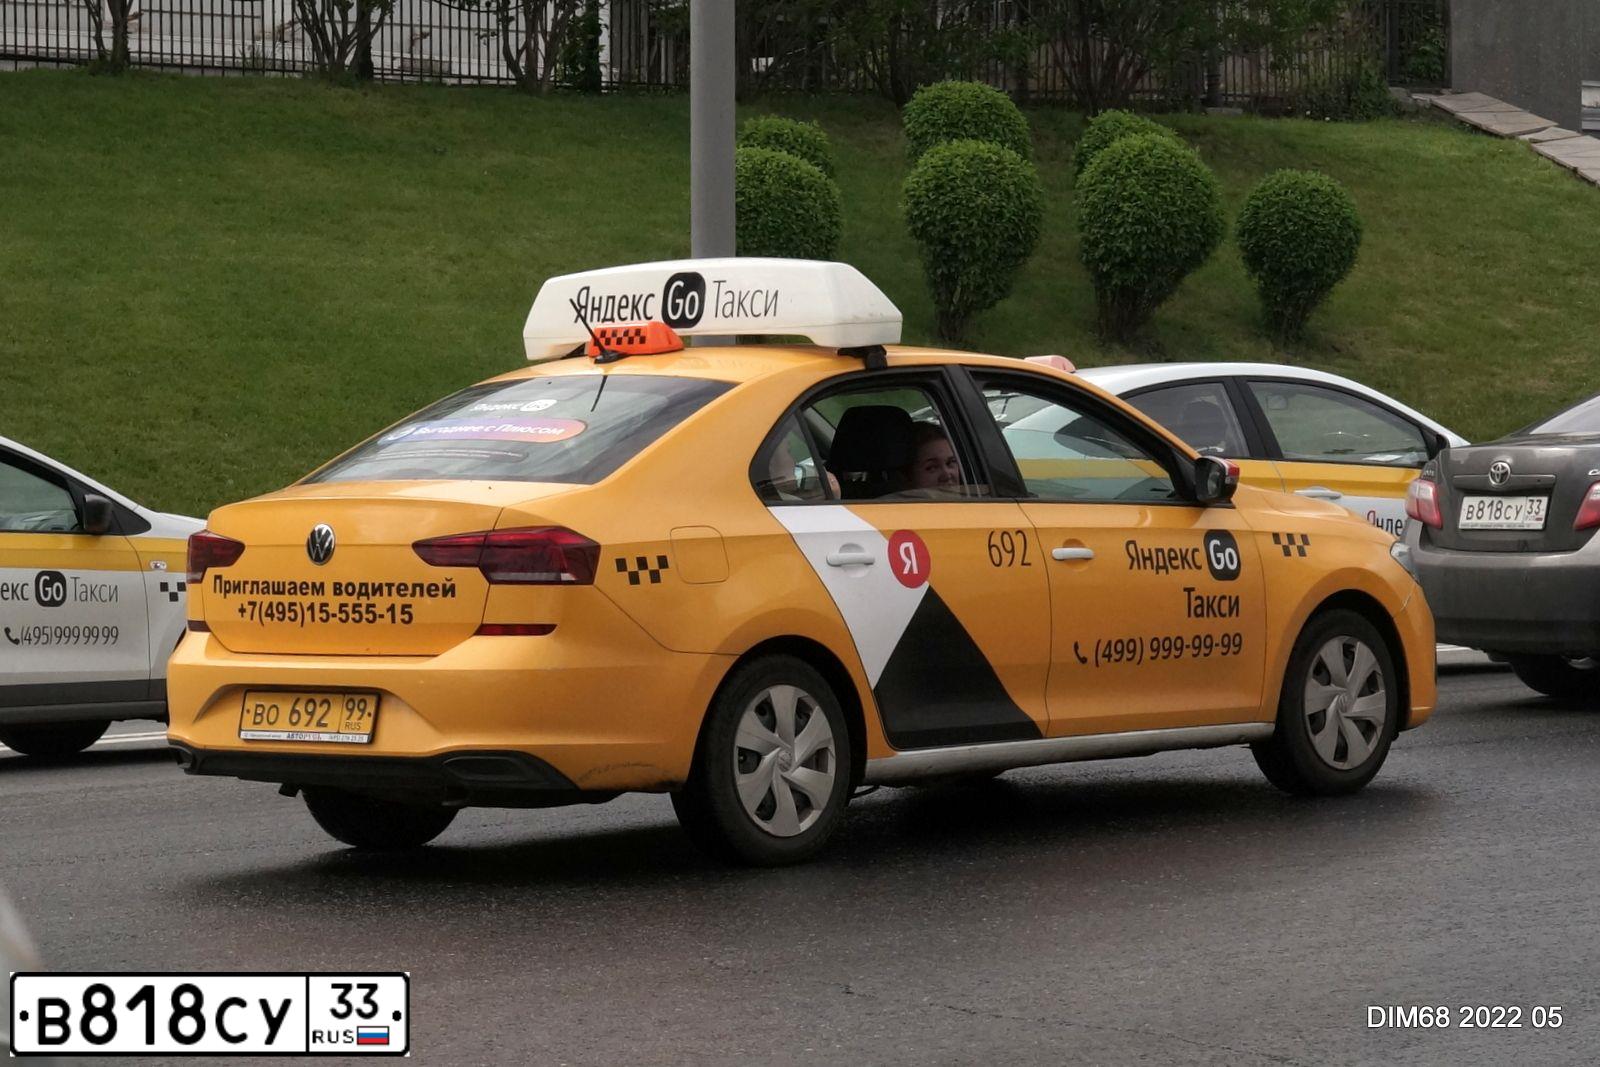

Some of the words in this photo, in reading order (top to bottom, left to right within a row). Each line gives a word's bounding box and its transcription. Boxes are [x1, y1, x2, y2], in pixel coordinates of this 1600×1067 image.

[574, 286, 655, 324] Яндекс
[666, 280, 699, 320] Go
[713, 280, 779, 319] Такси
[1527, 499, 1543, 515] 33
[900, 542, 919, 575] Я
[988, 530, 1032, 567] 692
[1125, 540, 1203, 575] Яндекс
[1208, 539, 1239, 571] Go
[39, 576, 64, 602] Go
[70, 577, 119, 602] Такси
[213, 575, 325, 599] Приглашаем
[333, 577, 456, 600] водителей
[1183, 587, 1240, 618] Такси
[238, 601, 413, 627] +7(495)15-555-15
[1094, 637, 1144, 668] (499)
[1150, 633, 1243, 660] 999-99-99
[288, 697, 331, 727] 692
[345, 698, 367, 721] 99
[345, 721, 361, 731] RUS
